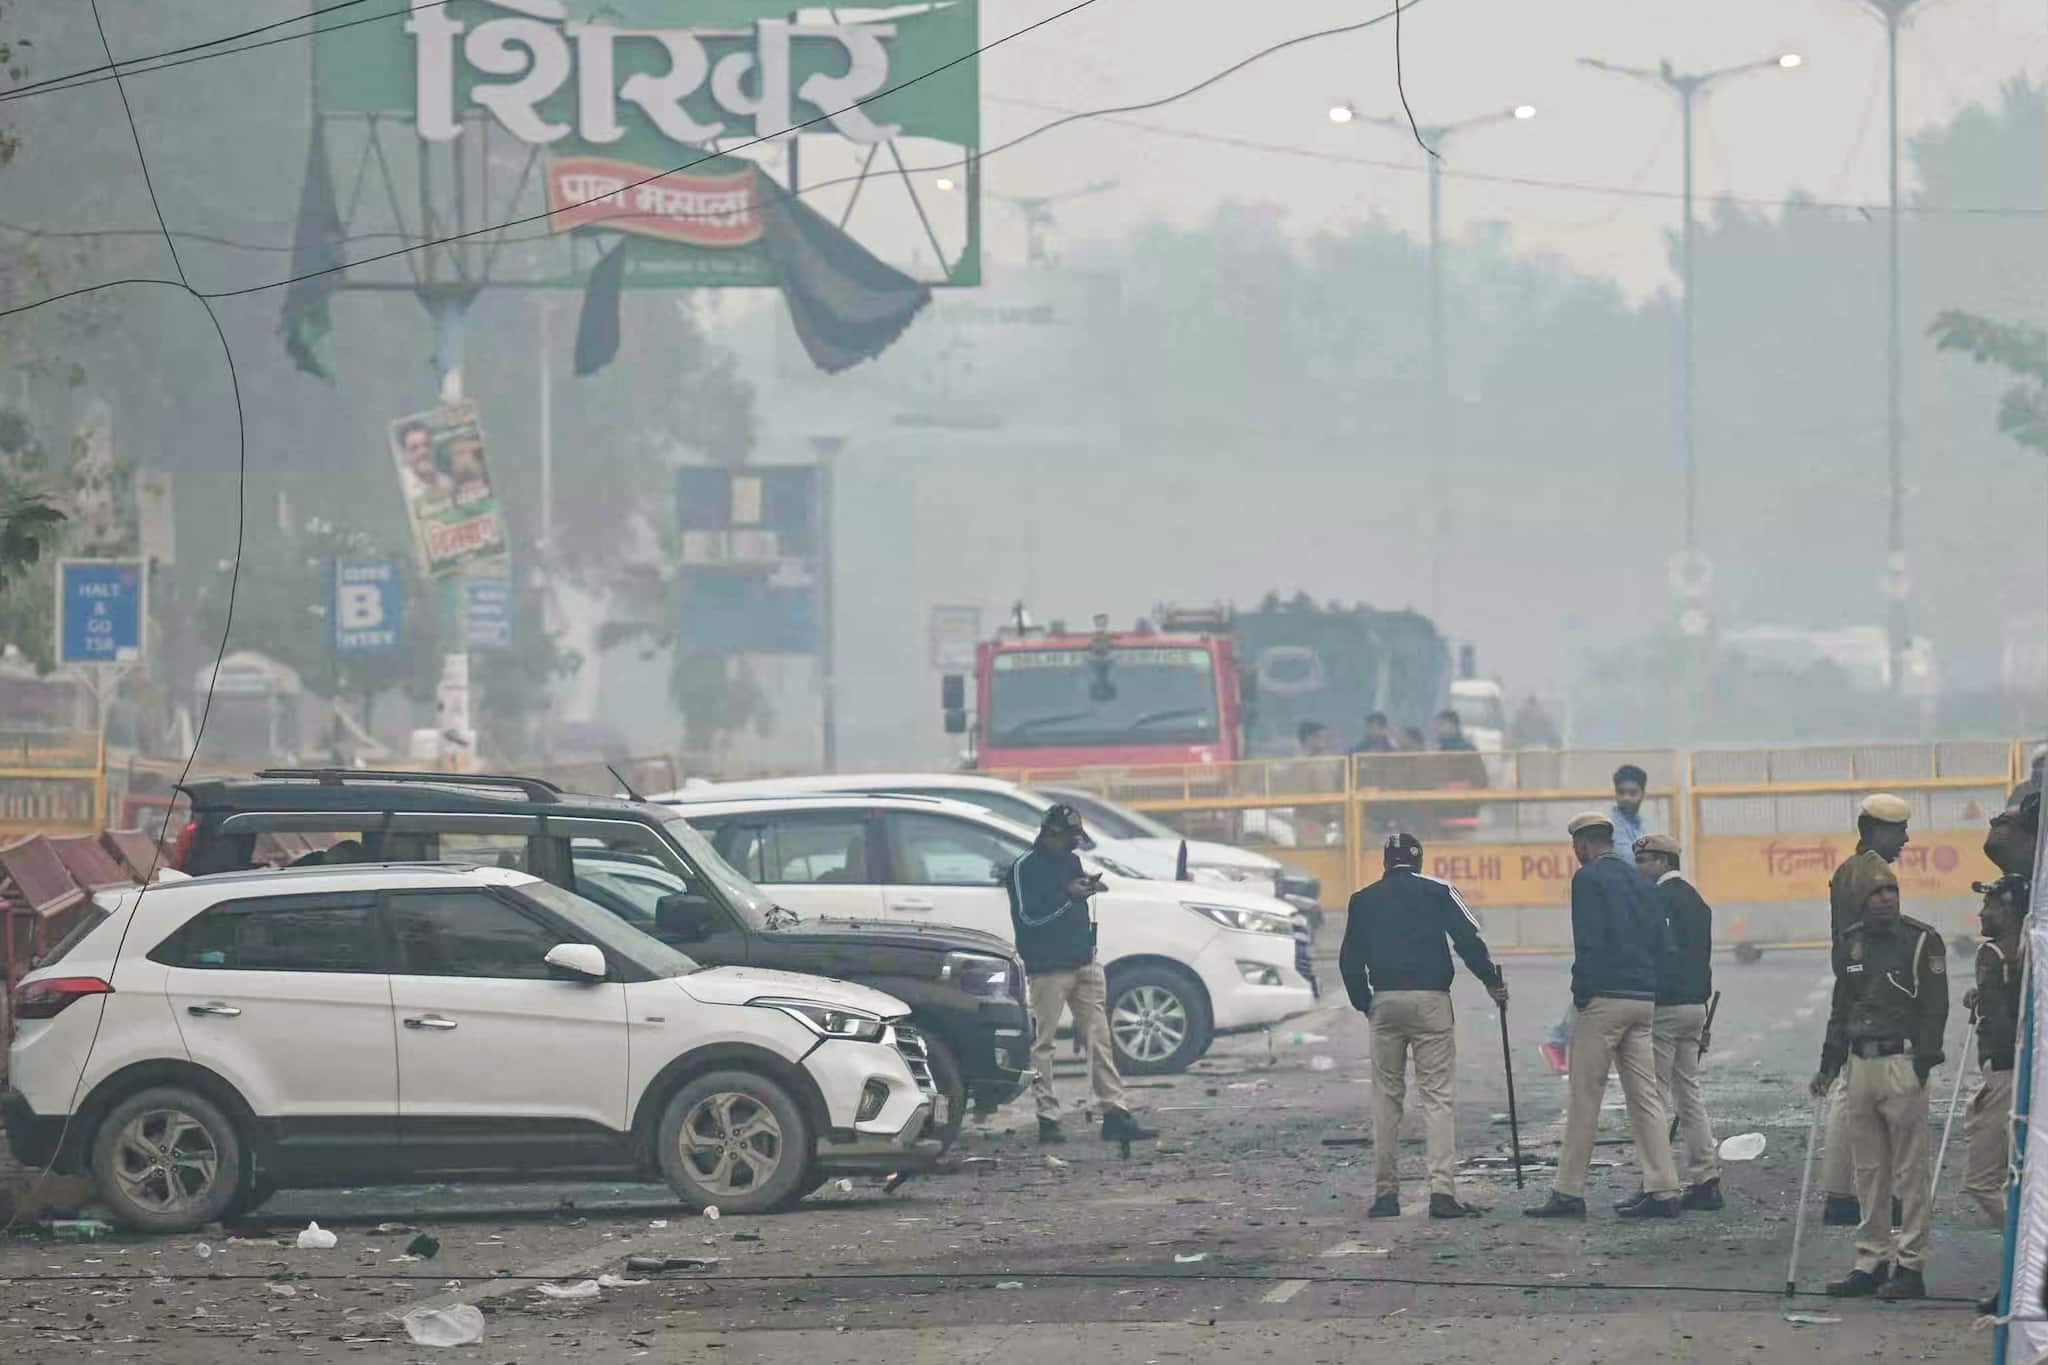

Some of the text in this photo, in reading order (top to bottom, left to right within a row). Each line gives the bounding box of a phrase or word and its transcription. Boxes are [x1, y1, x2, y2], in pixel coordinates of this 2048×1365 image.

[559, 174, 628, 209] पान
[79, 583, 120, 598] HALT
[338, 584, 383, 629] B
[1433, 854, 1574, 880] DELHI POLI
[1760, 838, 1838, 877] दिल्ली
